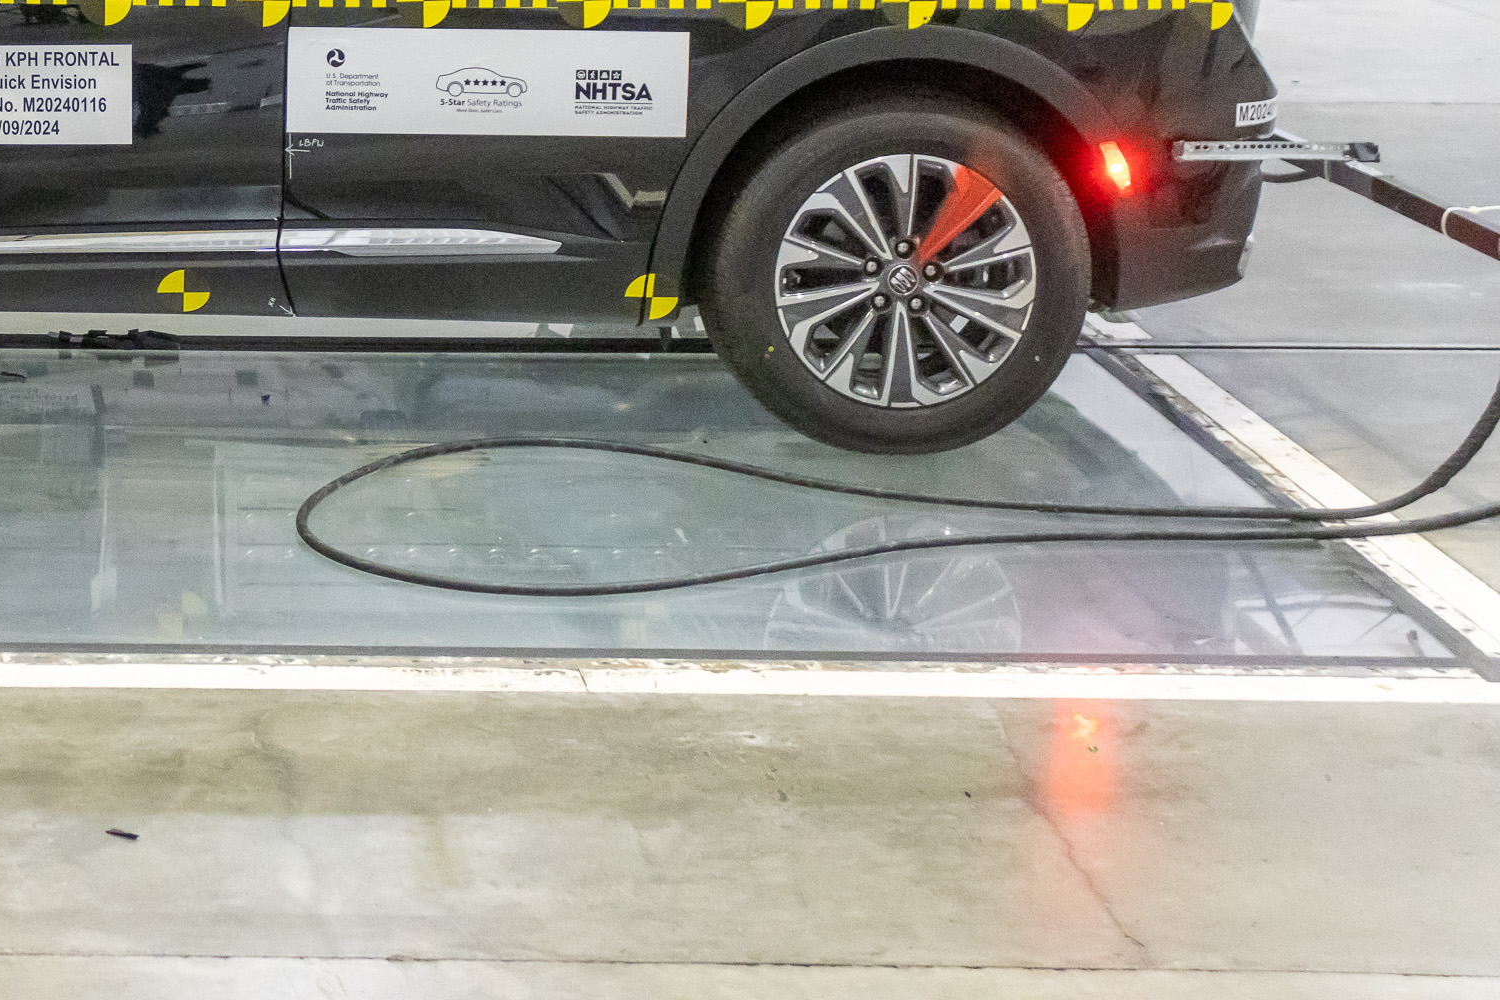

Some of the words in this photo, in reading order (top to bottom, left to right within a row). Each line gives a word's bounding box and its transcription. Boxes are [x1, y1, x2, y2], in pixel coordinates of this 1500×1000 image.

[5, 52, 38, 67] KPH
[44, 52, 120, 66] FRONTAL
[31, 74, 97, 90] Envision
[575, 82, 653, 101] NHTSA
[23, 98, 107, 112] M20240116
[467, 99, 491, 108] Safety
[493, 99, 522, 108] Ratings
